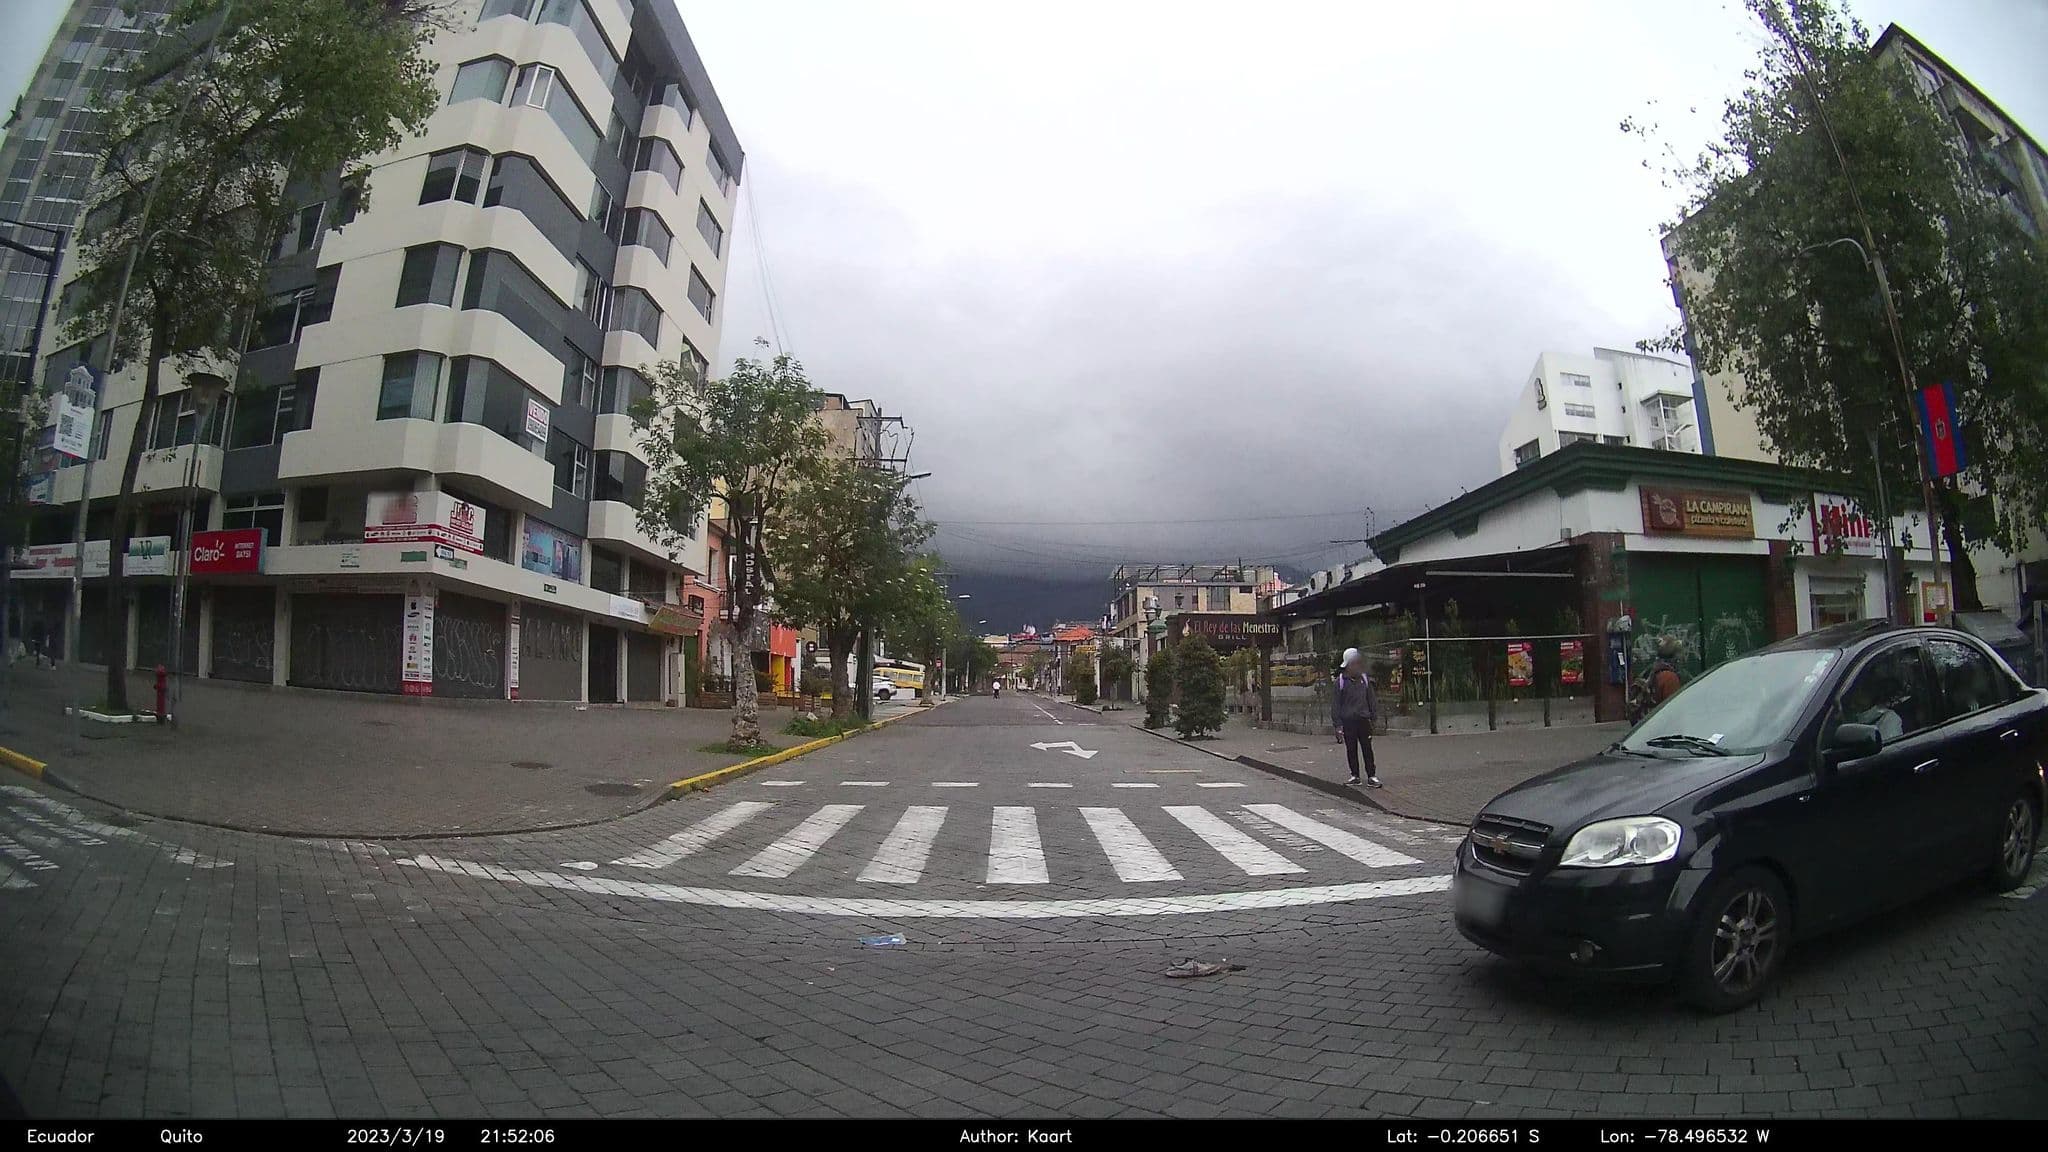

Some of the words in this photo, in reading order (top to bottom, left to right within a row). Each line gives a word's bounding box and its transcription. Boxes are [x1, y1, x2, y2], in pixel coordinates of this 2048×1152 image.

[1686, 500, 1699, 513] LA
[1700, 501, 1749, 516] CAMPIRANA
[194, 546, 220, 562] Claro
[1203, 620, 1217, 635] Rey
[1219, 621, 1228, 633] de
[1231, 620, 1241, 633] las
[1242, 621, 1280, 634] Menestras
